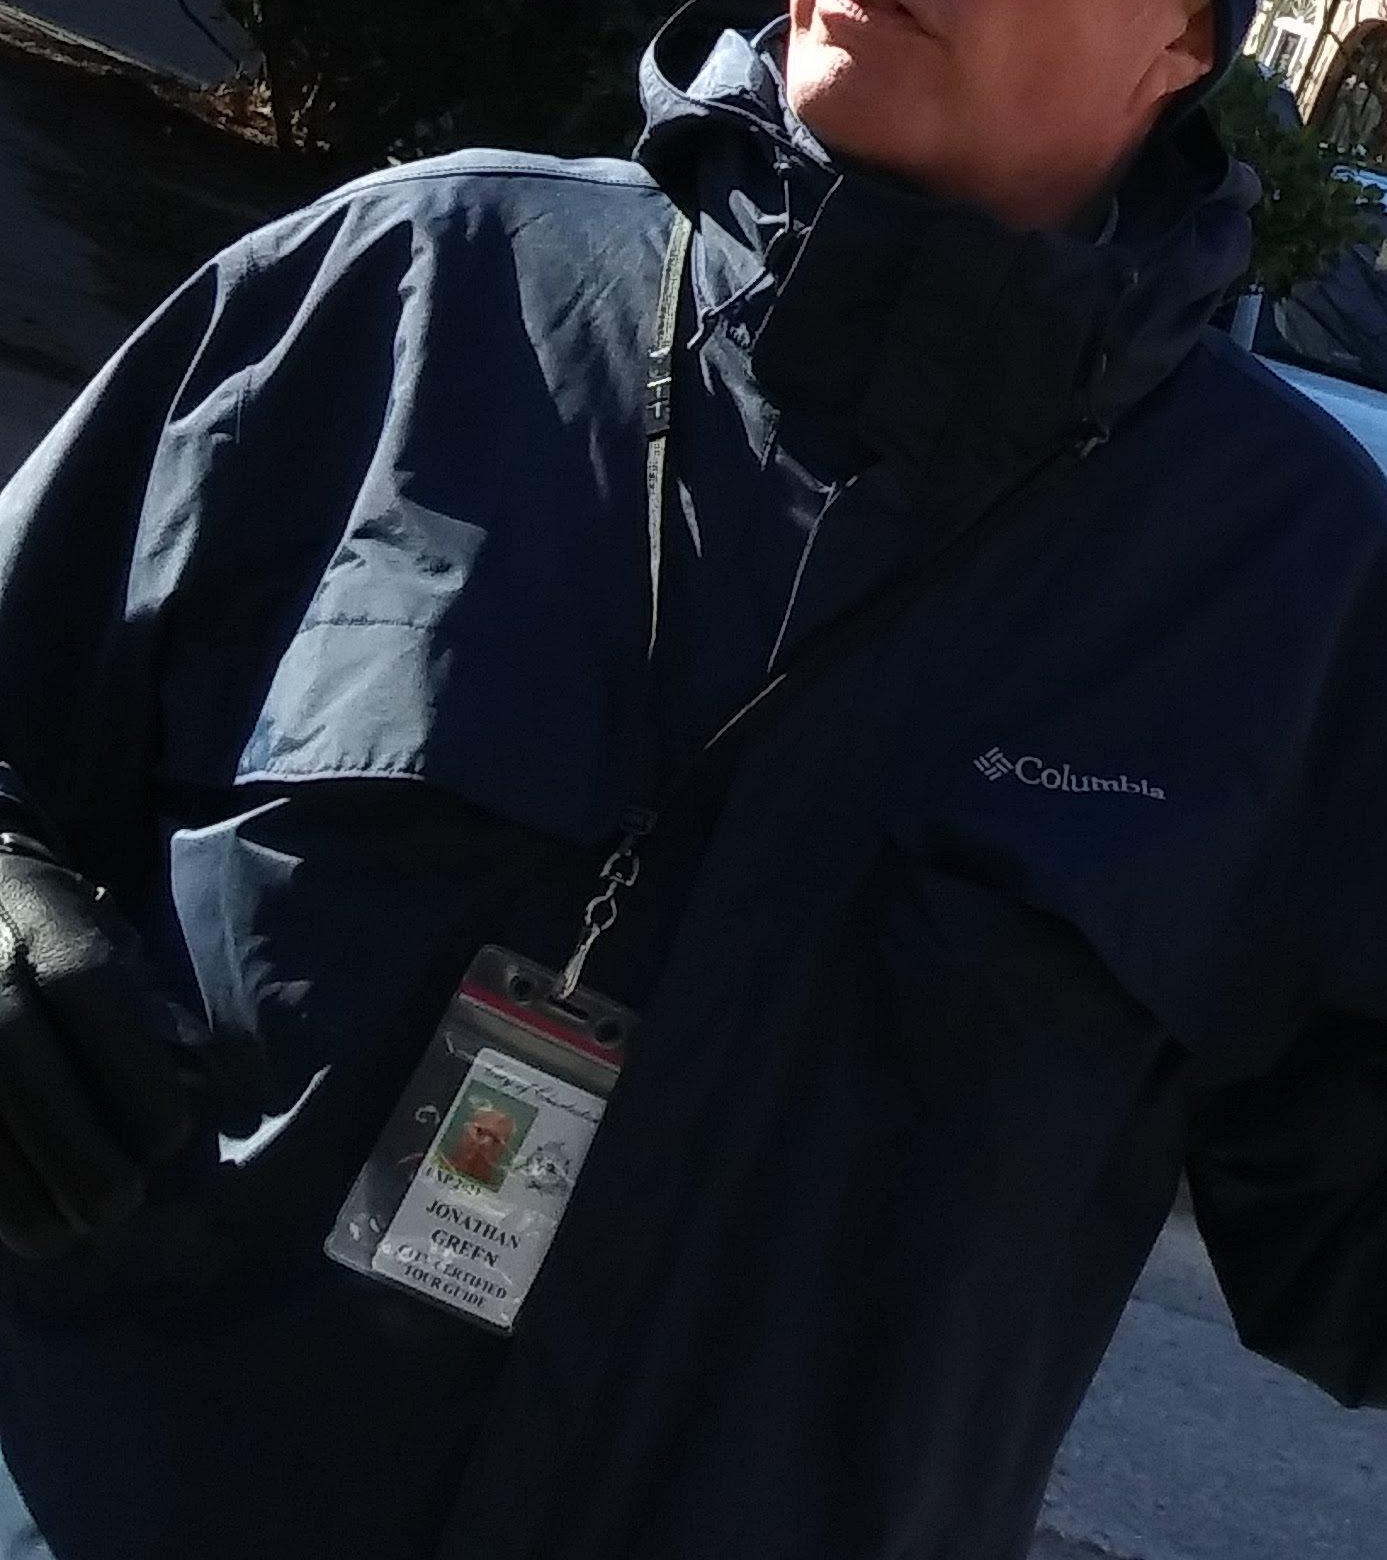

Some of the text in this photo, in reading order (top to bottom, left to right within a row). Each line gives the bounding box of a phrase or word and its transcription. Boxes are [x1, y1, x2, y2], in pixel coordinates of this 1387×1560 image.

[1014, 755, 1167, 801] Columbia
[425, 1199, 520, 1250] JONATHAN
[431, 1229, 499, 1268] GREEN
[404, 1264, 442, 1290] TOUR
